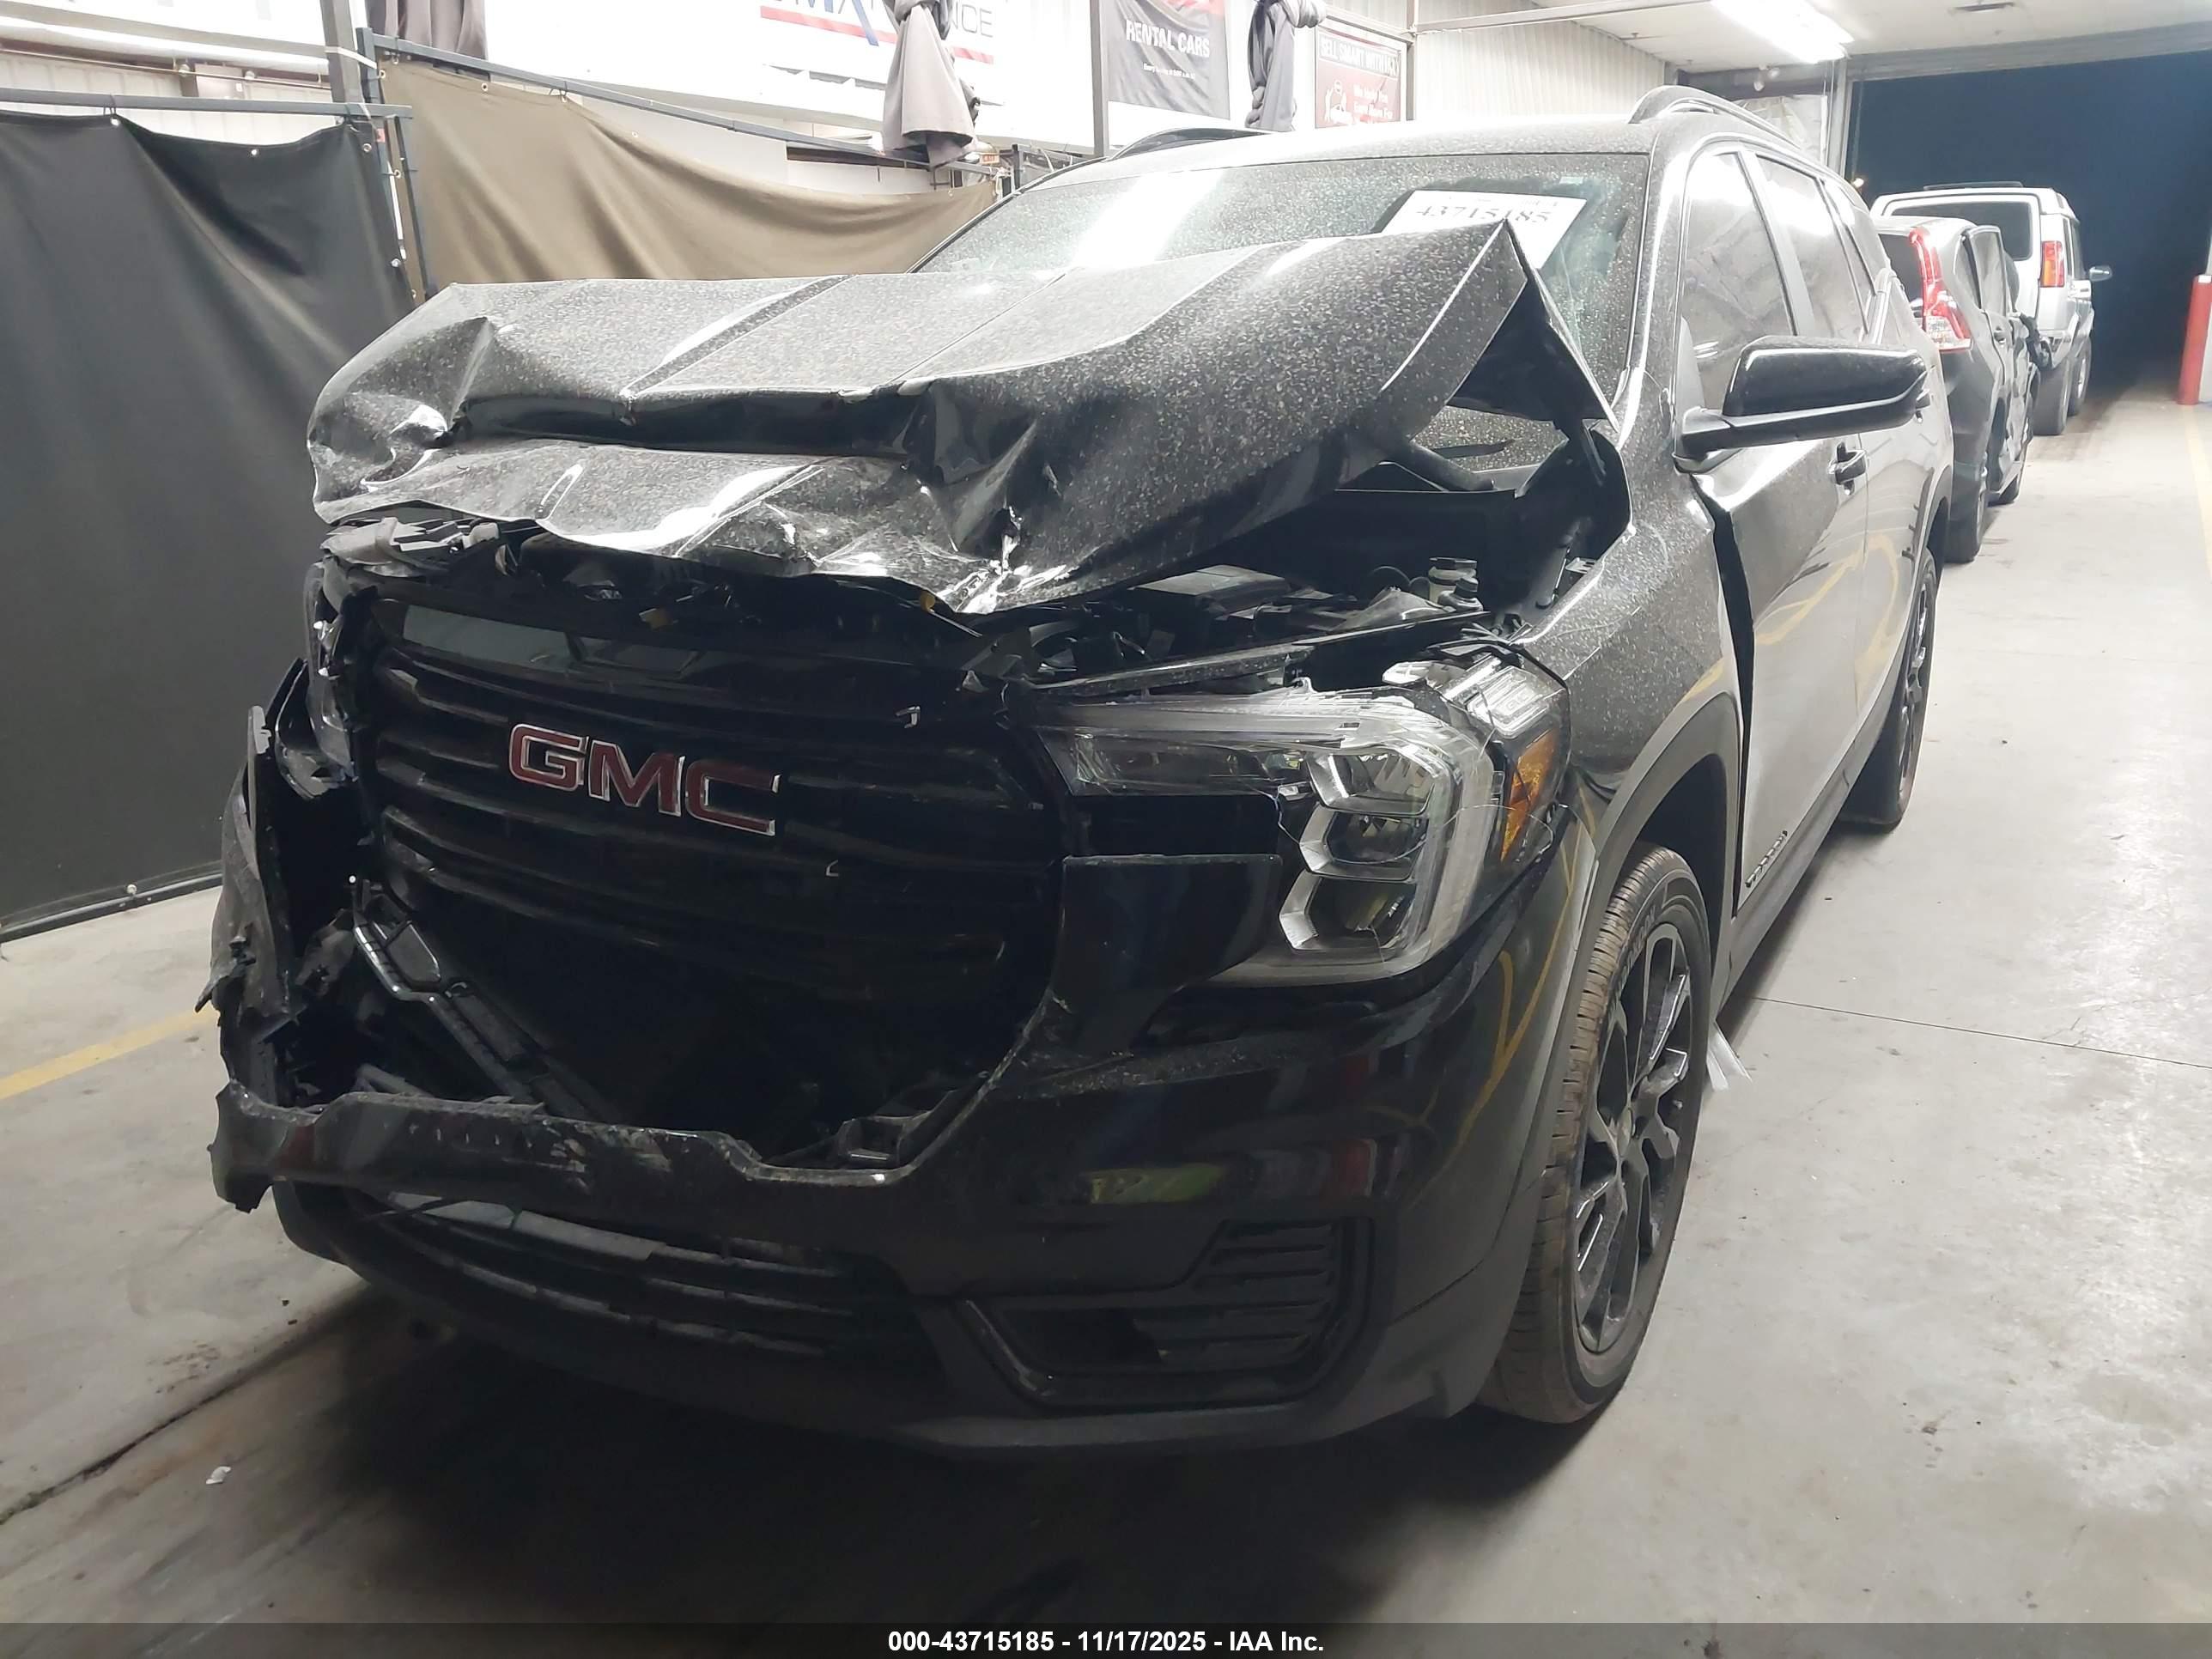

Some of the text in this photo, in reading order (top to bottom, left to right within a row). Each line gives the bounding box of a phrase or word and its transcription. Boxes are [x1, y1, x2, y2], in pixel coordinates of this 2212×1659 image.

[1126, 19, 1210, 58] RENTAL CARS
[1321, 36, 1339, 59] SELL
[1340, 42, 1364, 68] SMART
[509, 724, 781, 836] GMC
